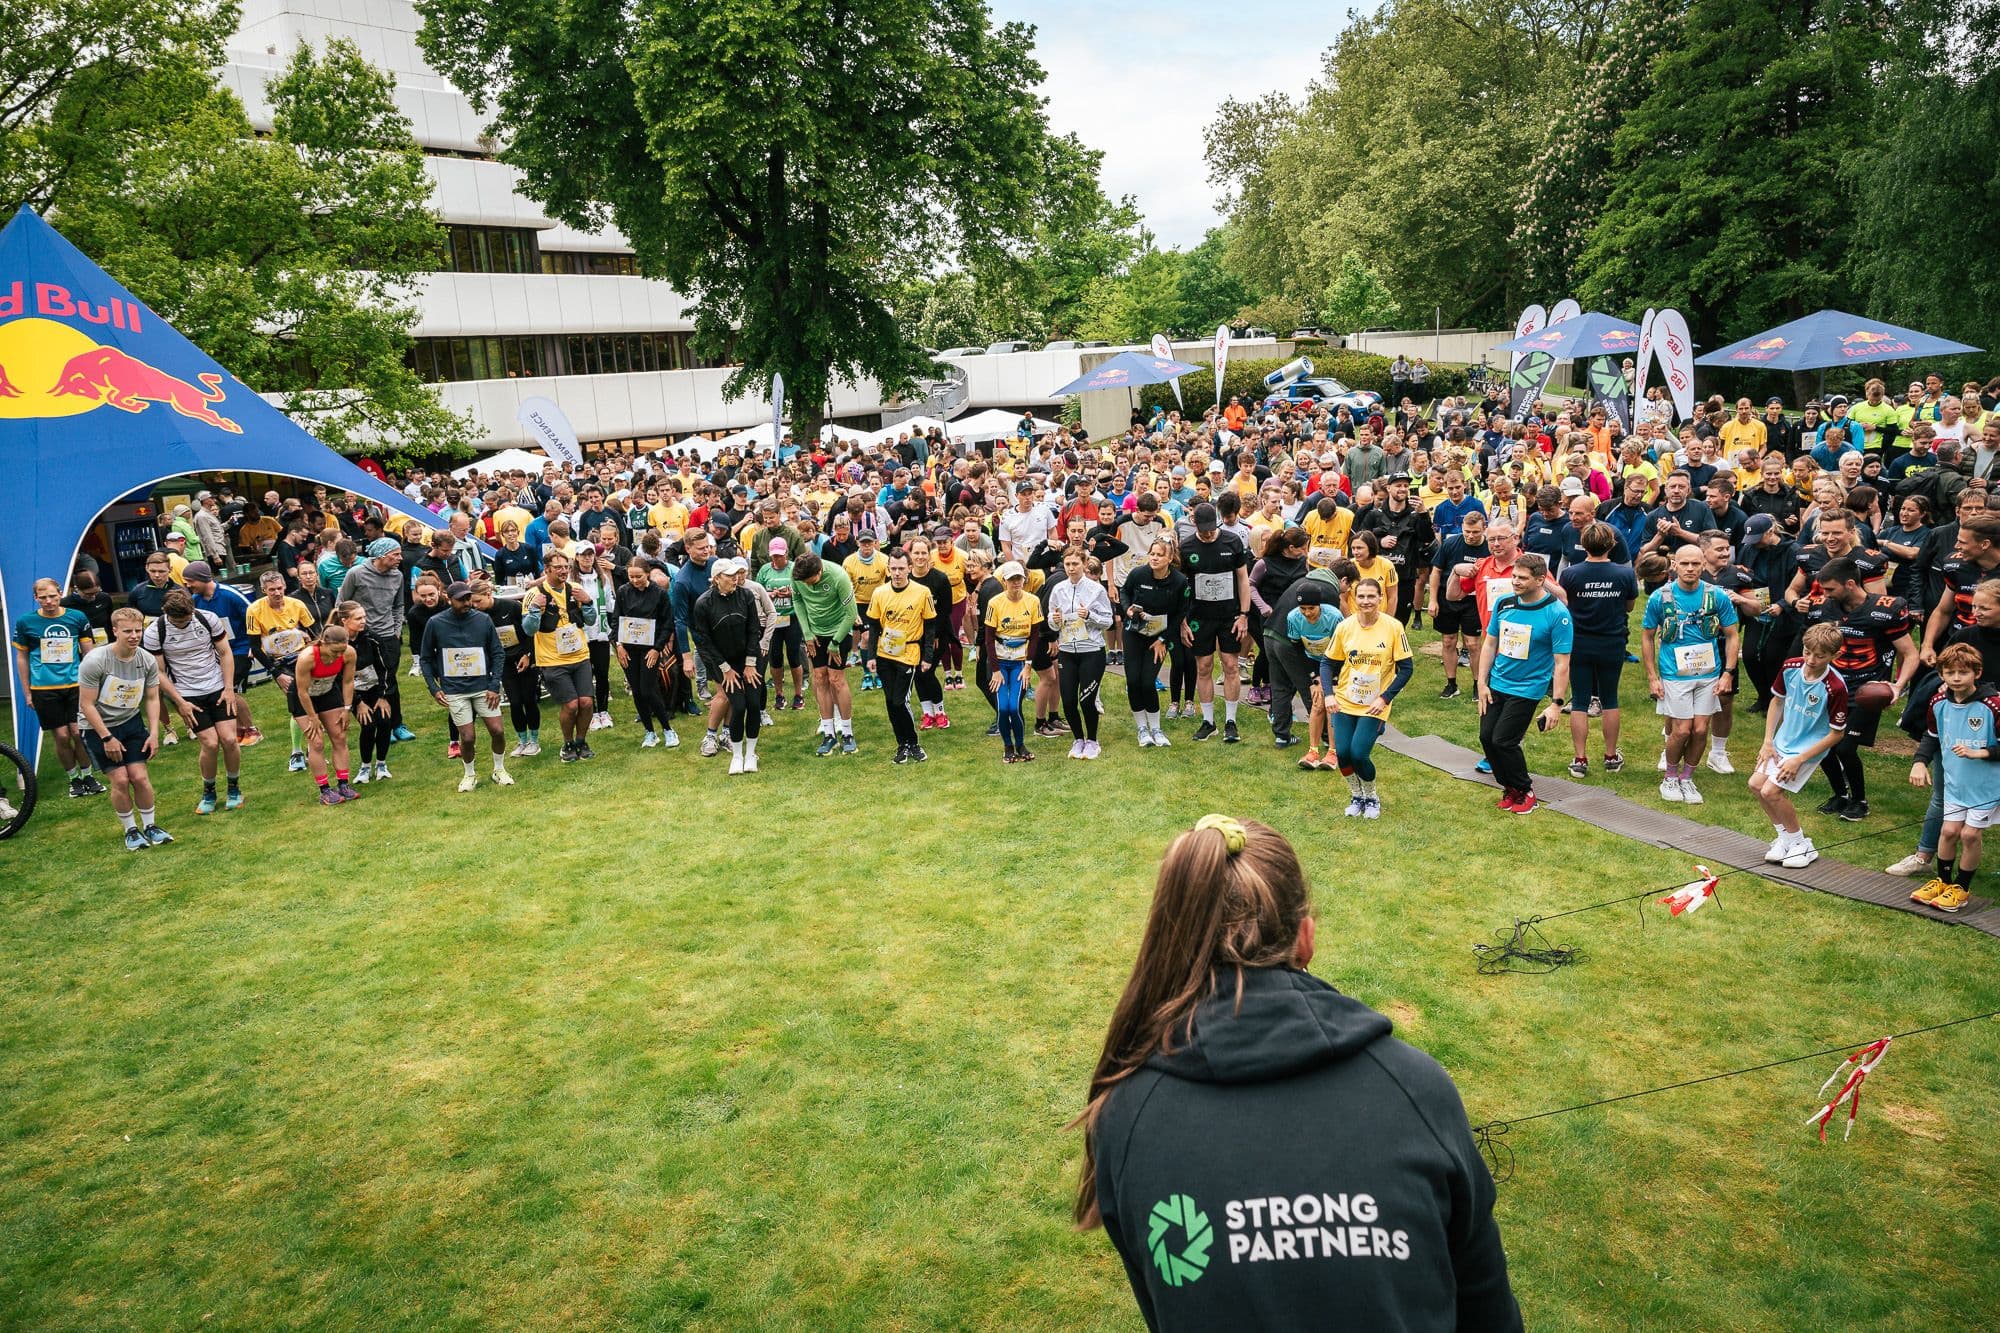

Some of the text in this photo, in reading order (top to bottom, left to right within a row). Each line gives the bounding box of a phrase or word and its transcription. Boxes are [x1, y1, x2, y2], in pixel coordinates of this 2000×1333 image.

[35, 282, 142, 334] Bull
[1521, 324, 1535, 337] LBS
[1841, 341, 1913, 357] Red Bull
[1225, 1192, 1378, 1231] STRONG
[1229, 1226, 1410, 1264] PARTNERS
